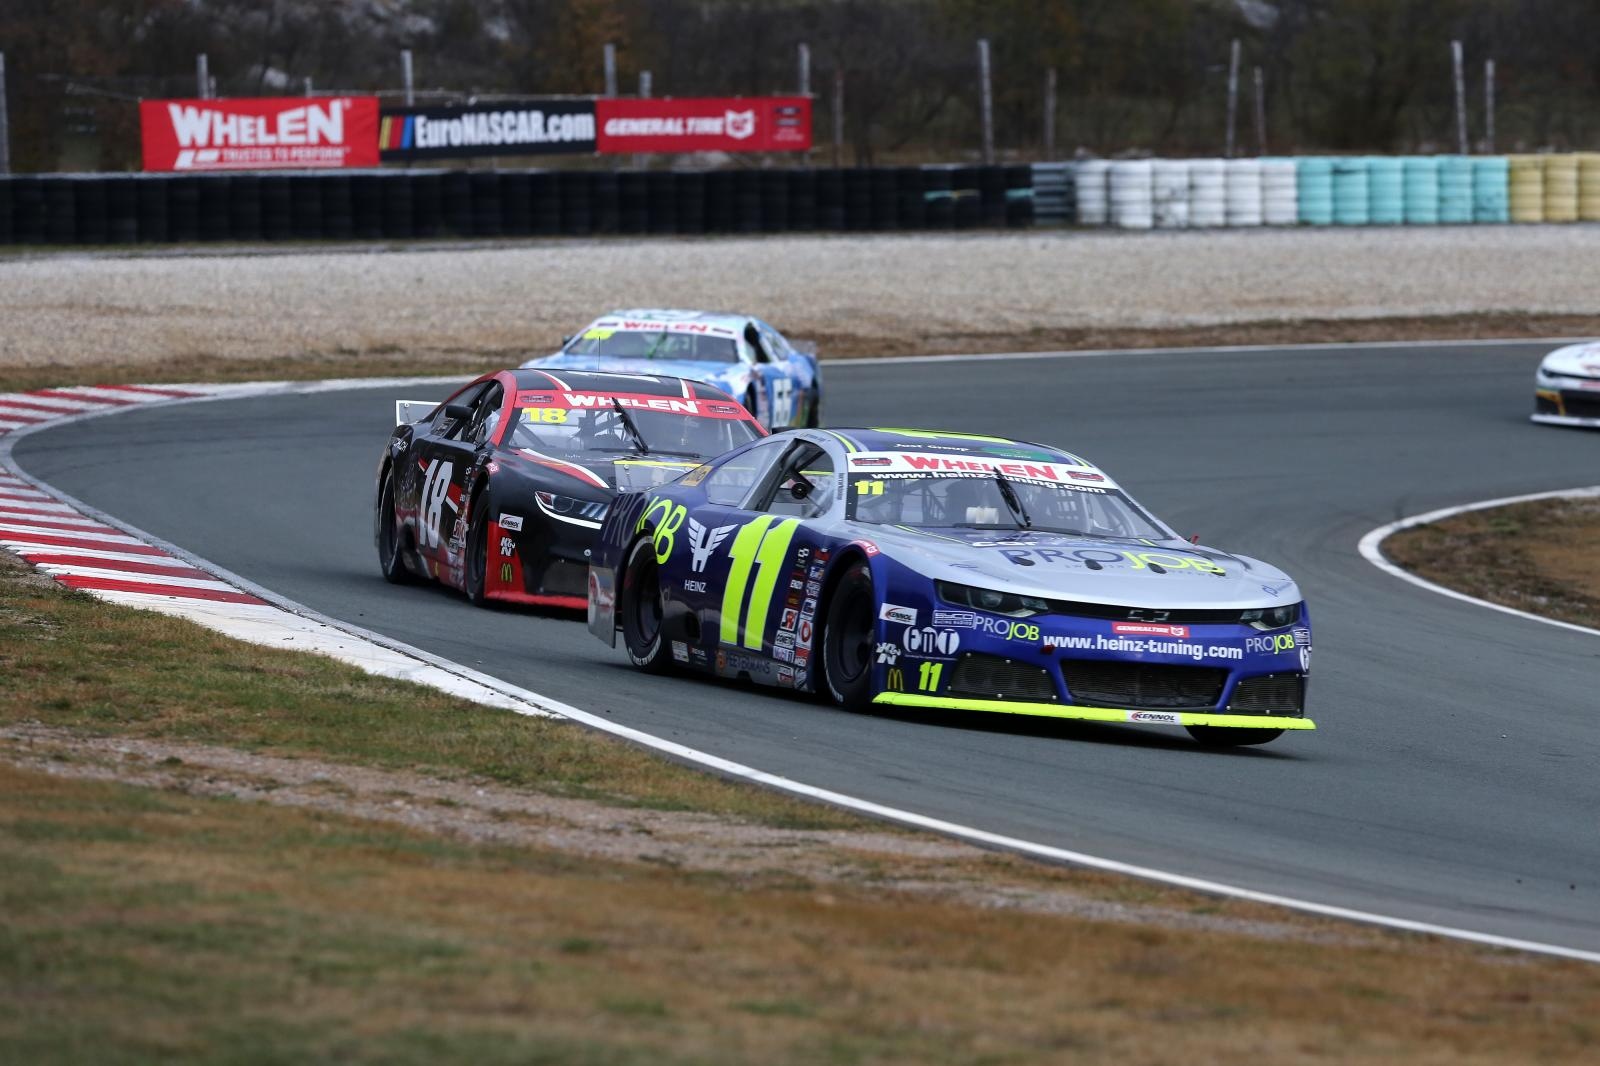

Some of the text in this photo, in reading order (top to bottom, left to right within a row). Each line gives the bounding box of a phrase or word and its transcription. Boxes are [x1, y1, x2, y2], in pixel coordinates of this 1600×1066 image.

[168, 99, 343, 147] WHELEN
[414, 111, 595, 148] EuroNASCAR.com
[604, 117, 724, 136] GENERAL TIRE
[522, 407, 567, 423] 18
[563, 393, 699, 413] WHELEN
[902, 455, 1059, 480] WHELEN
[854, 480, 884, 496] 11
[420, 459, 453, 548] 18
[684, 579, 707, 593] HEINZ
[720, 514, 804, 651] 11
[973, 616, 1040, 641] PROJOB
[1043, 635, 1243, 660] www.heinz-tuning.com
[1245, 634, 1295, 655] PROJOB
[918, 661, 943, 692] 11
[1135, 713, 1175, 721] KENNOL
